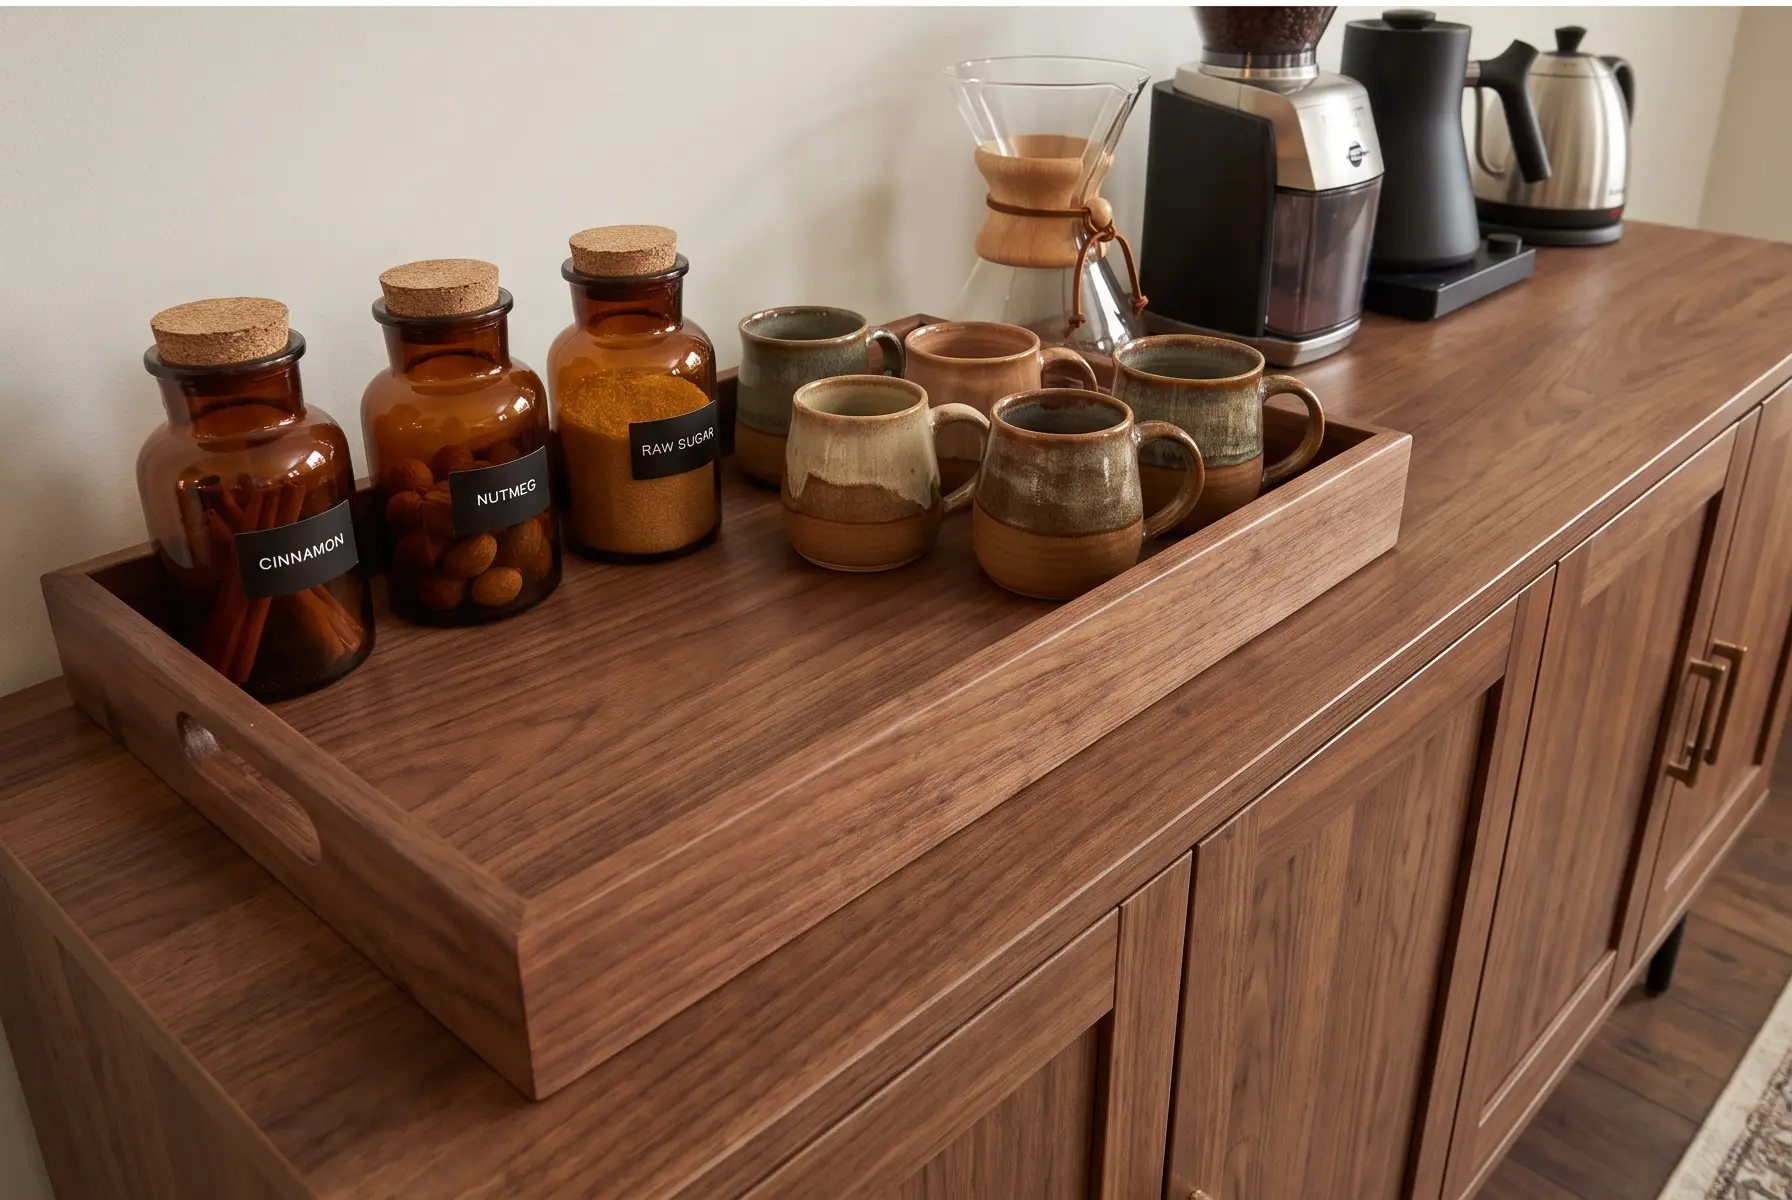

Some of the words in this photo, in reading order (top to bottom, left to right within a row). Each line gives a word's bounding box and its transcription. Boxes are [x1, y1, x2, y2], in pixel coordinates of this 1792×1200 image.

[641, 441, 674, 456] RAW
[678, 426, 714, 450] SUGAR
[477, 478, 537, 507] NUTMEG
[259, 532, 345, 570] CINNAMON
